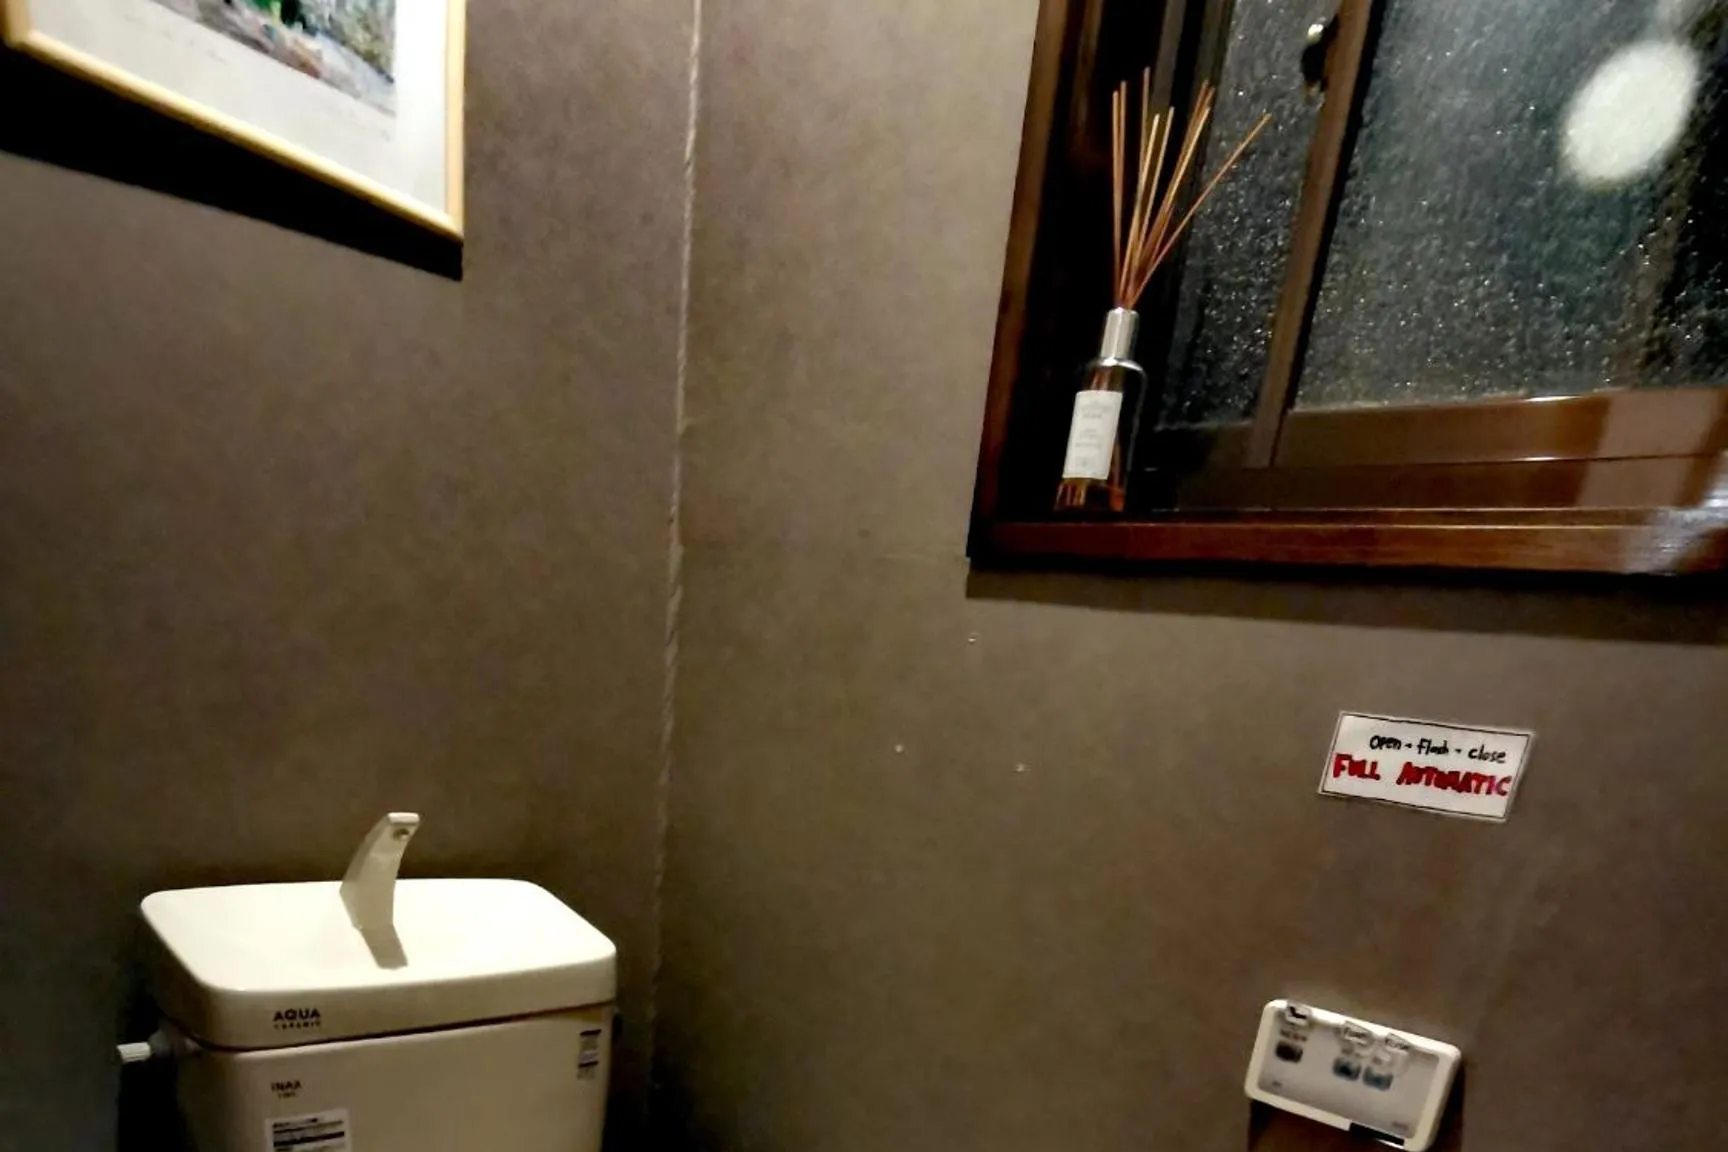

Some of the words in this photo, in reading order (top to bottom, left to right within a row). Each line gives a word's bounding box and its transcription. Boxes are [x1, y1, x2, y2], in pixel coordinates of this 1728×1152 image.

[1468, 744, 1507, 764] close
[1333, 753, 1381, 781] FULL
[273, 1008, 321, 1022] AQUA
